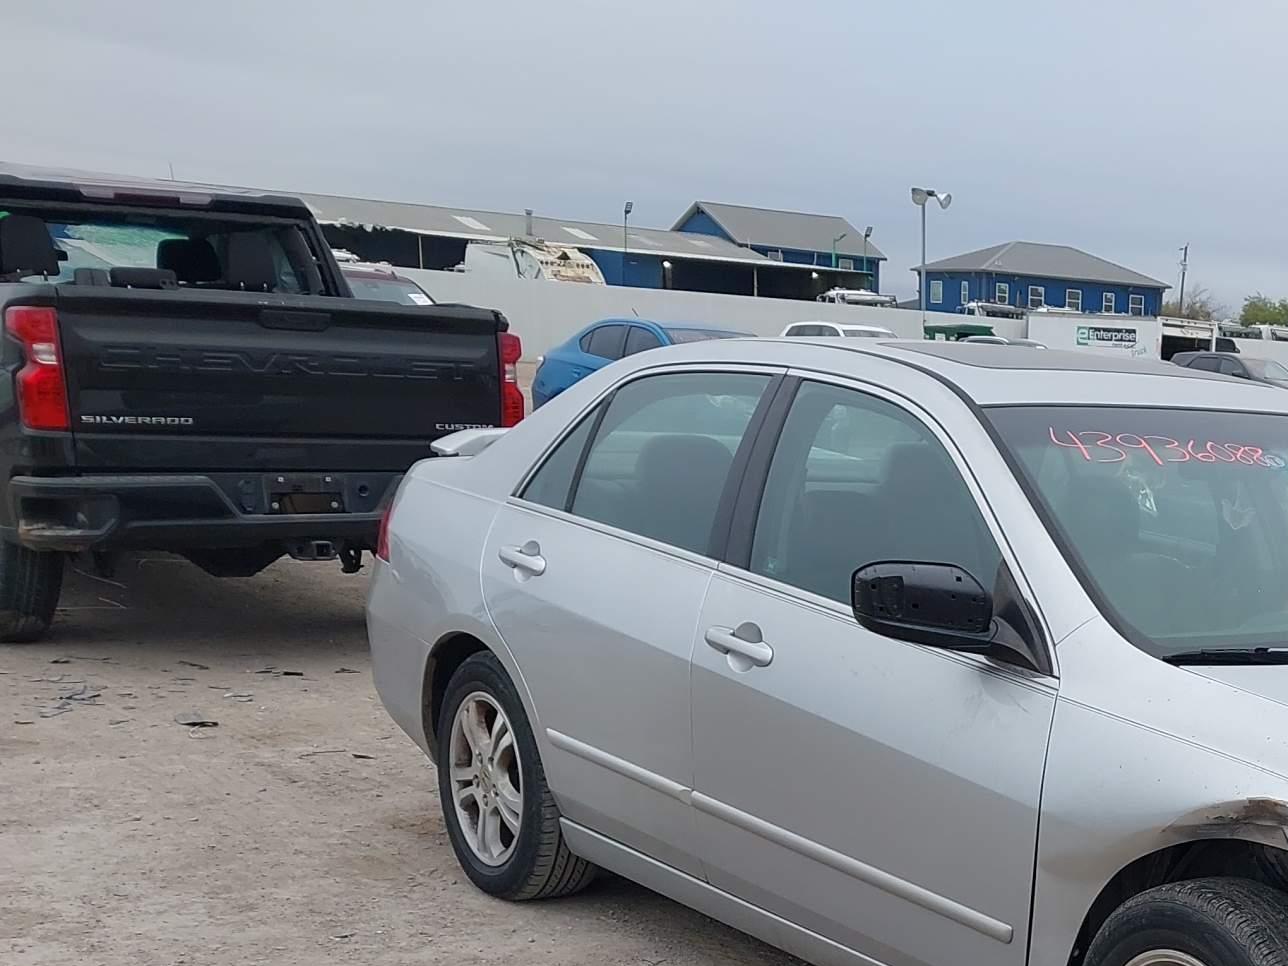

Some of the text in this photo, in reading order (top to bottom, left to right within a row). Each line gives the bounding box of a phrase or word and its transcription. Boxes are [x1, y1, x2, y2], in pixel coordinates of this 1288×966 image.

[1089, 329, 1136, 342] Enterprise
[80, 415, 194, 425] SILVERADO
[1049, 426, 1270, 467] 43936088
